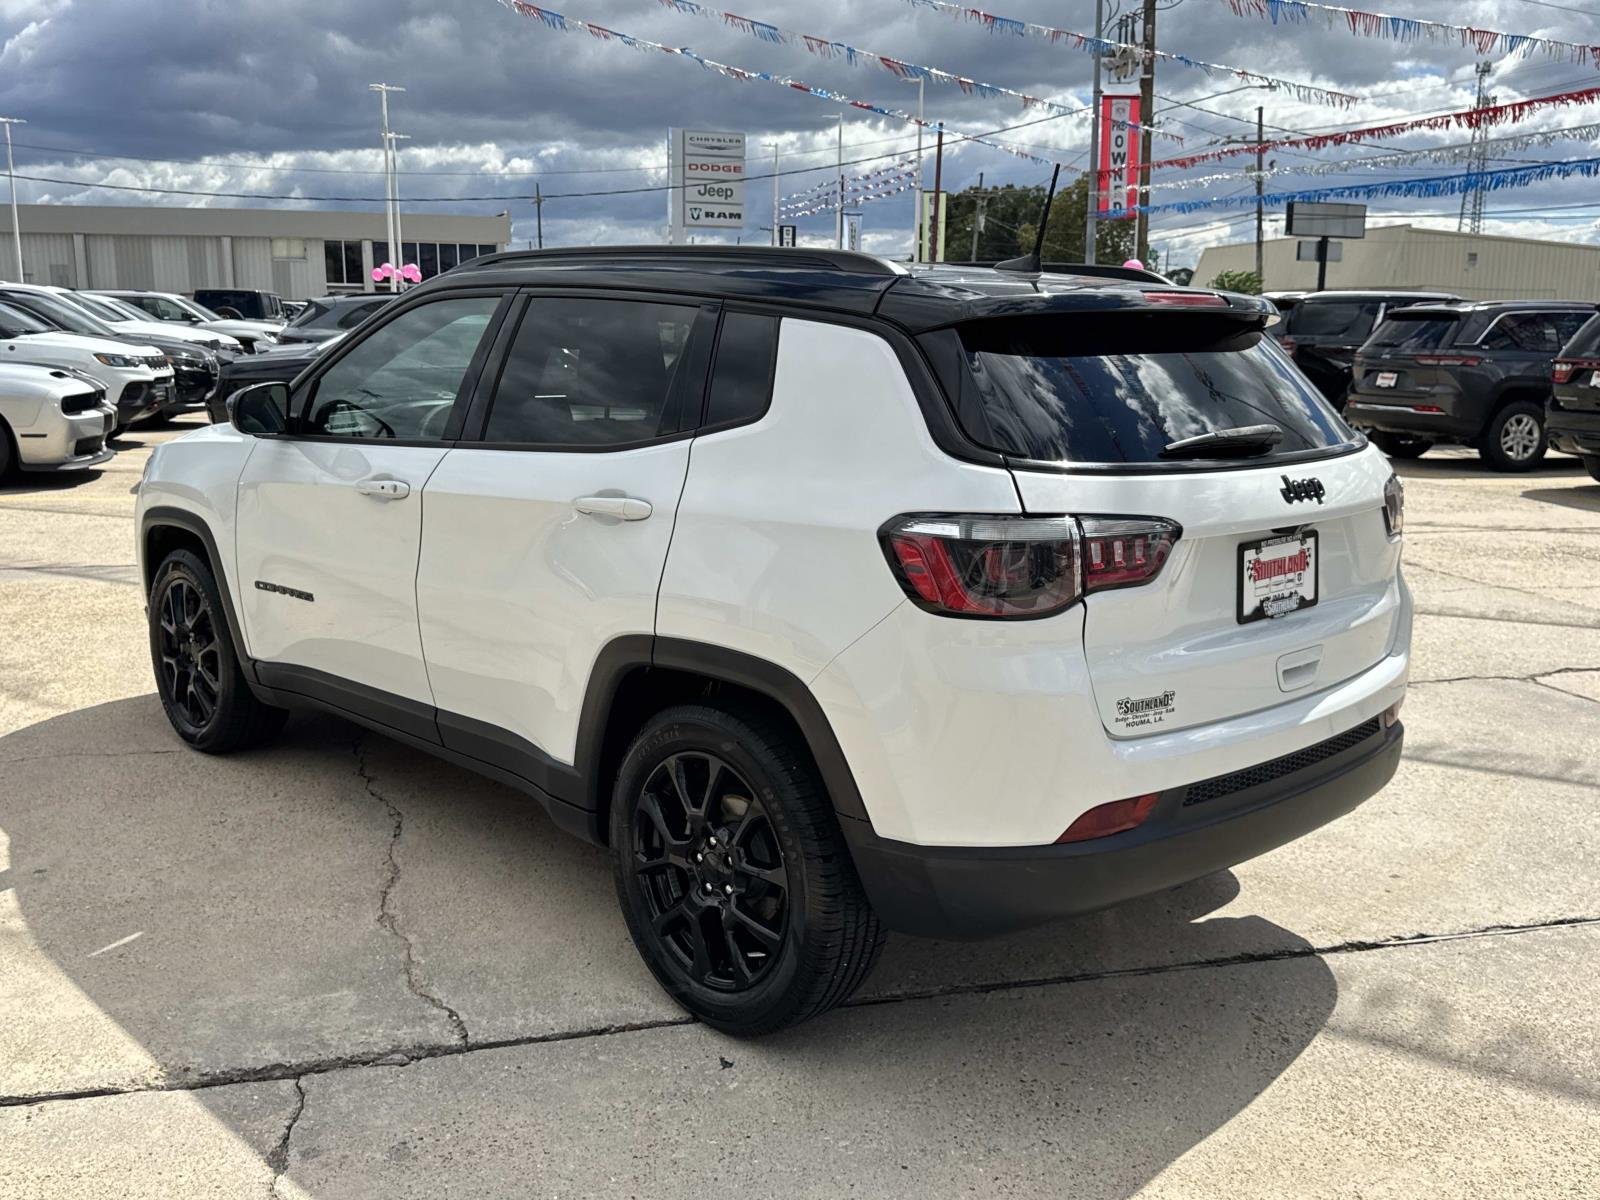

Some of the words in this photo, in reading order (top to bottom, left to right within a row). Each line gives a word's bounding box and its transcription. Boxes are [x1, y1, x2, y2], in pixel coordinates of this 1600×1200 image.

[689, 136, 741, 144] CHRYSLER
[688, 163, 742, 173] DODGE
[697, 184, 734, 200] Jeep
[704, 211, 742, 220] RAM
[1280, 474, 1326, 505] Jeep
[1253, 549, 1306, 582] SOUTHLAND
[1123, 693, 1170, 714] SOUTHLAND
[1125, 718, 1152, 728] HOUMA,
